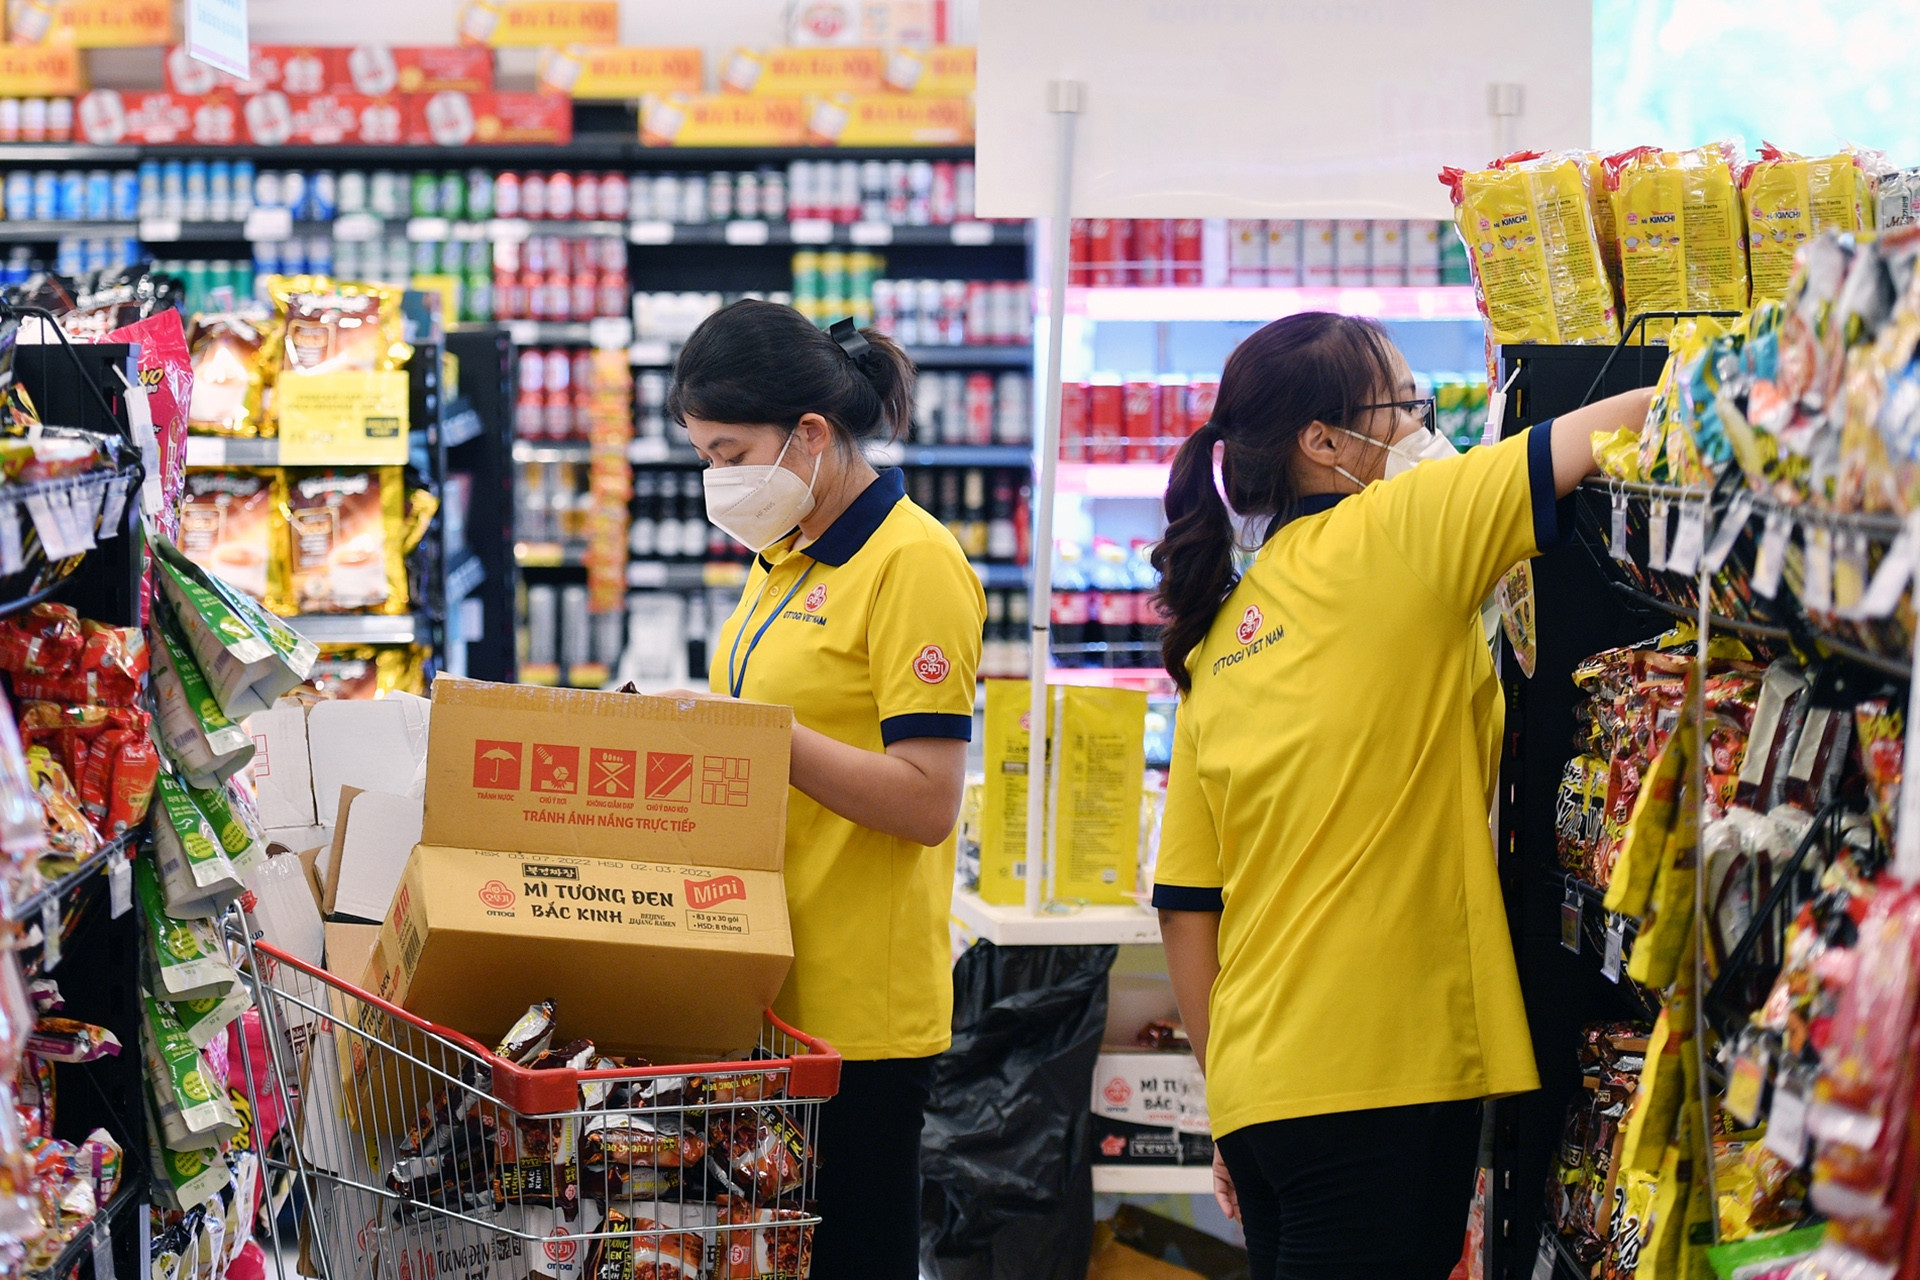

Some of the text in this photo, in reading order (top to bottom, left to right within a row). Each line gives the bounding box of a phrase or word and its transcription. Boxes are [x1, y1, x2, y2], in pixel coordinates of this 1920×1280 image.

[1649, 214, 1676, 224] KIMCHI
[1775, 210, 1801, 220] KIMCHI
[1501, 214, 1528, 227] KIMCHI
[1213, 625, 1285, 676] OTTOGI VIET NAM
[477, 791, 496, 801] TRÁNH
[523, 809, 697, 833] TRÁNH ÁNH NẮNG TRỰC TIẾP
[597, 861, 624, 869] HSD
[523, 880, 675, 908] MÌ TƯƠNG ĐEN
[693, 878, 739, 905] Mini
[486, 909, 516, 918] OTTOGI
[531, 902, 623, 924] BẮC KINH
[640, 913, 666, 921] BEIJING
[654, 919, 677, 928] RAMEN
